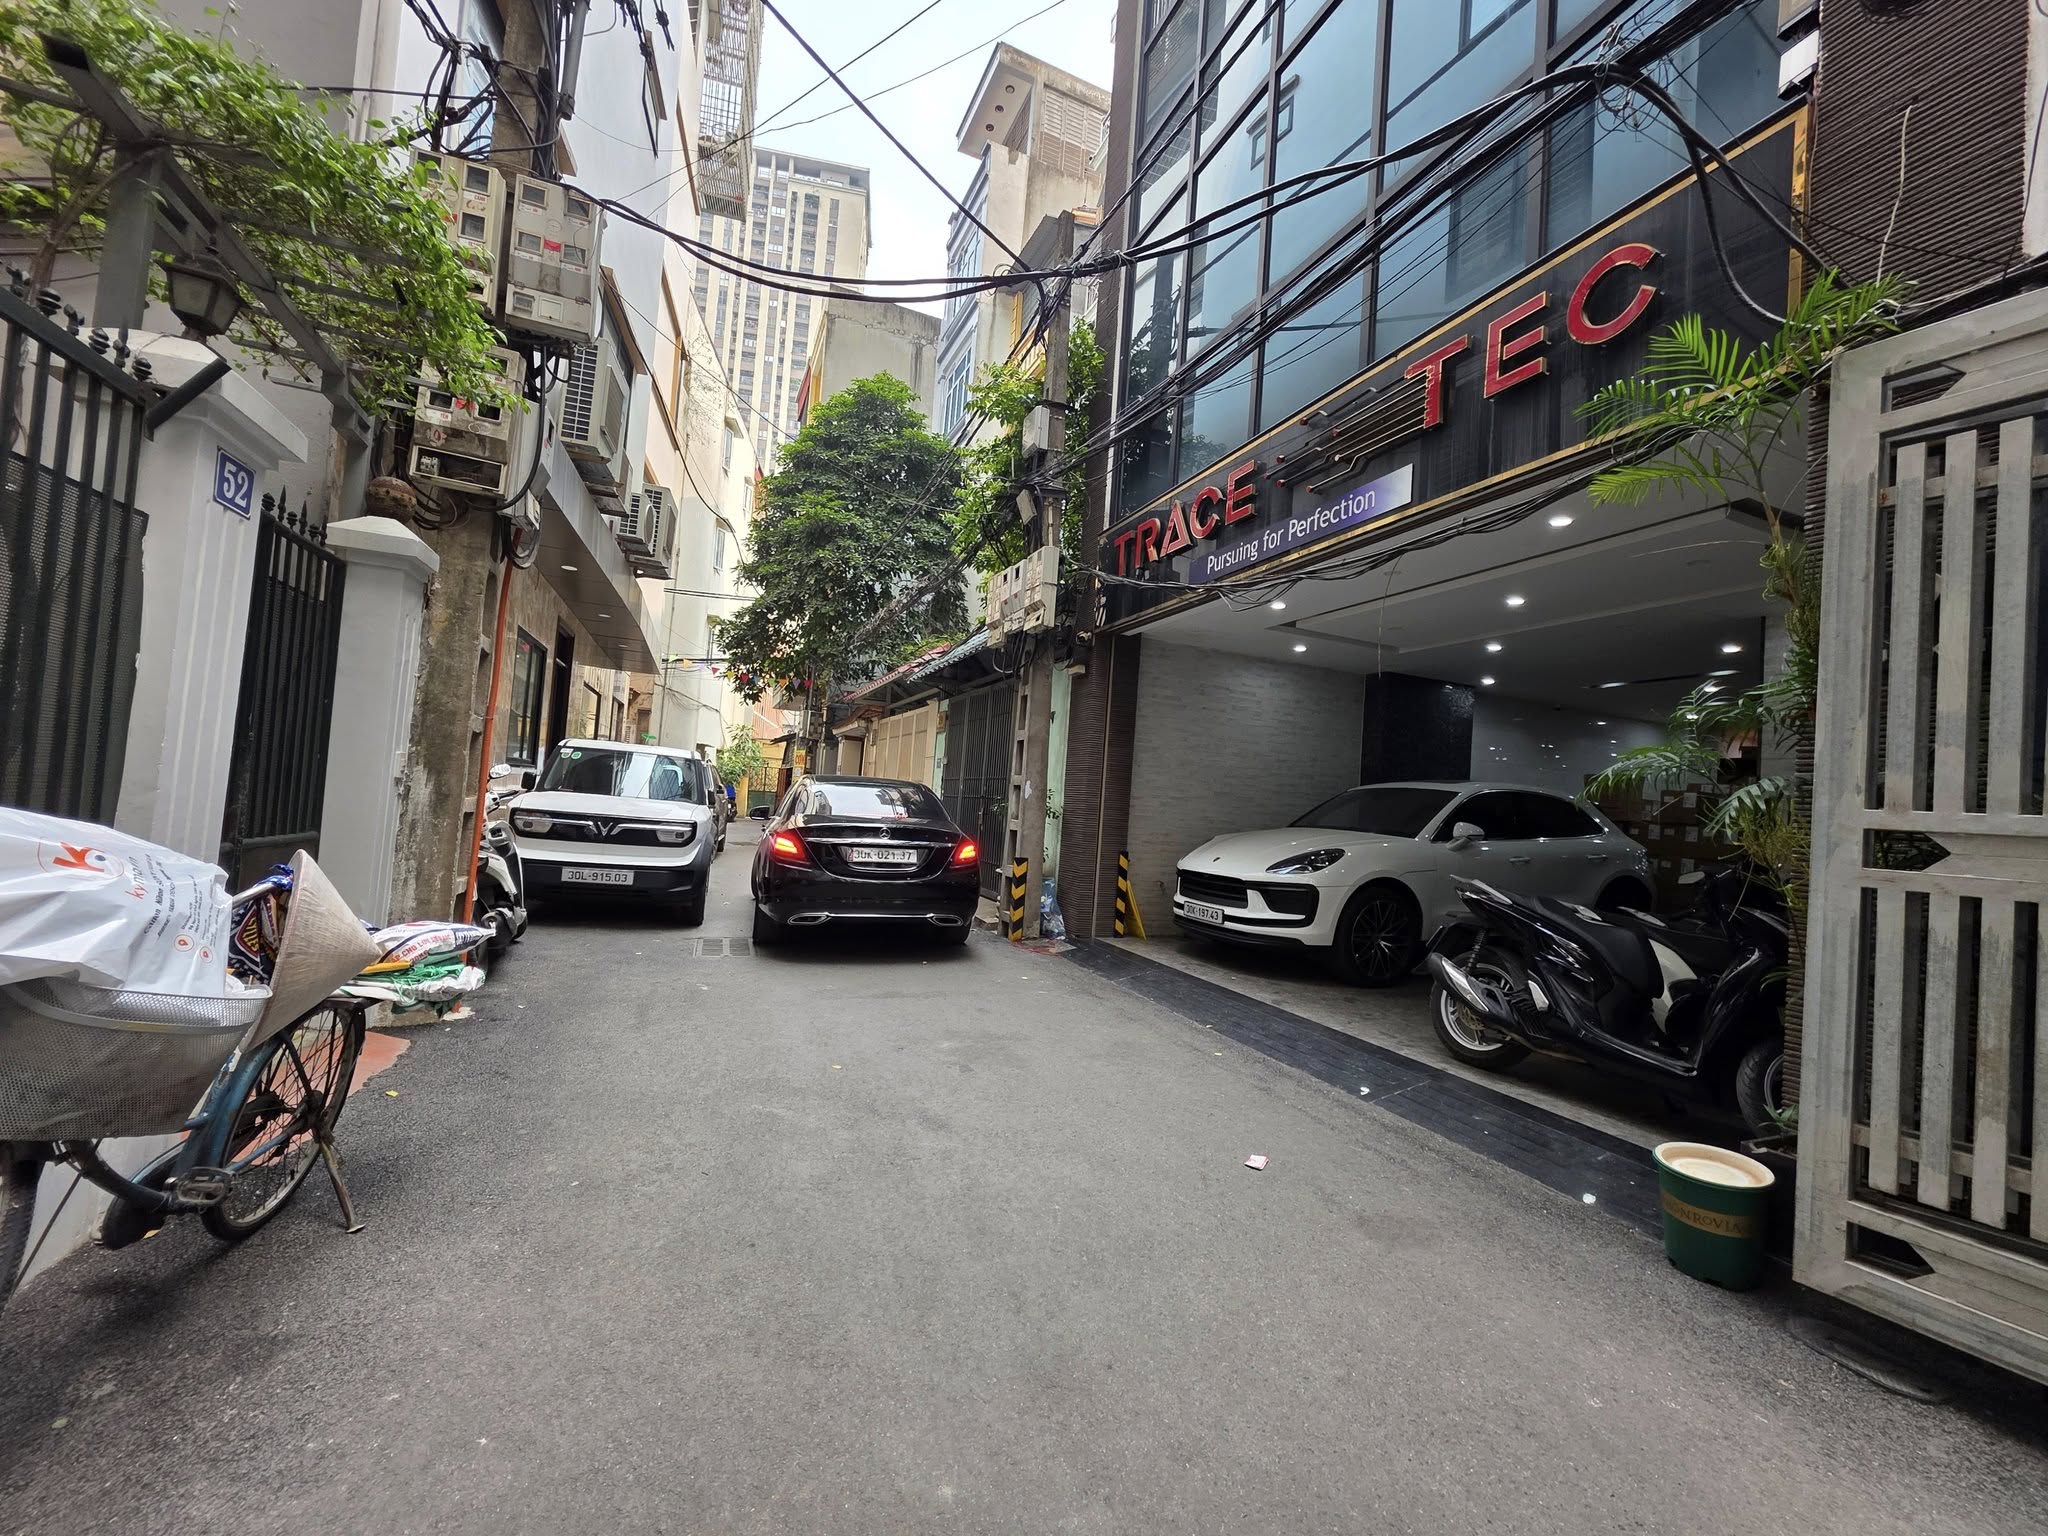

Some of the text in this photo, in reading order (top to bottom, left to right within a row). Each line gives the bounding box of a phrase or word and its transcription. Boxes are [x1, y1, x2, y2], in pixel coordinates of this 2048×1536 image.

[1114, 243, 1657, 577] TRACE TEC
[223, 461, 249, 508] 52
[1207, 489, 1376, 575] Pursuing for Perfection
[567, 870, 628, 882] 30L-915.03
[1186, 904, 1219, 921] 30K-197.43
